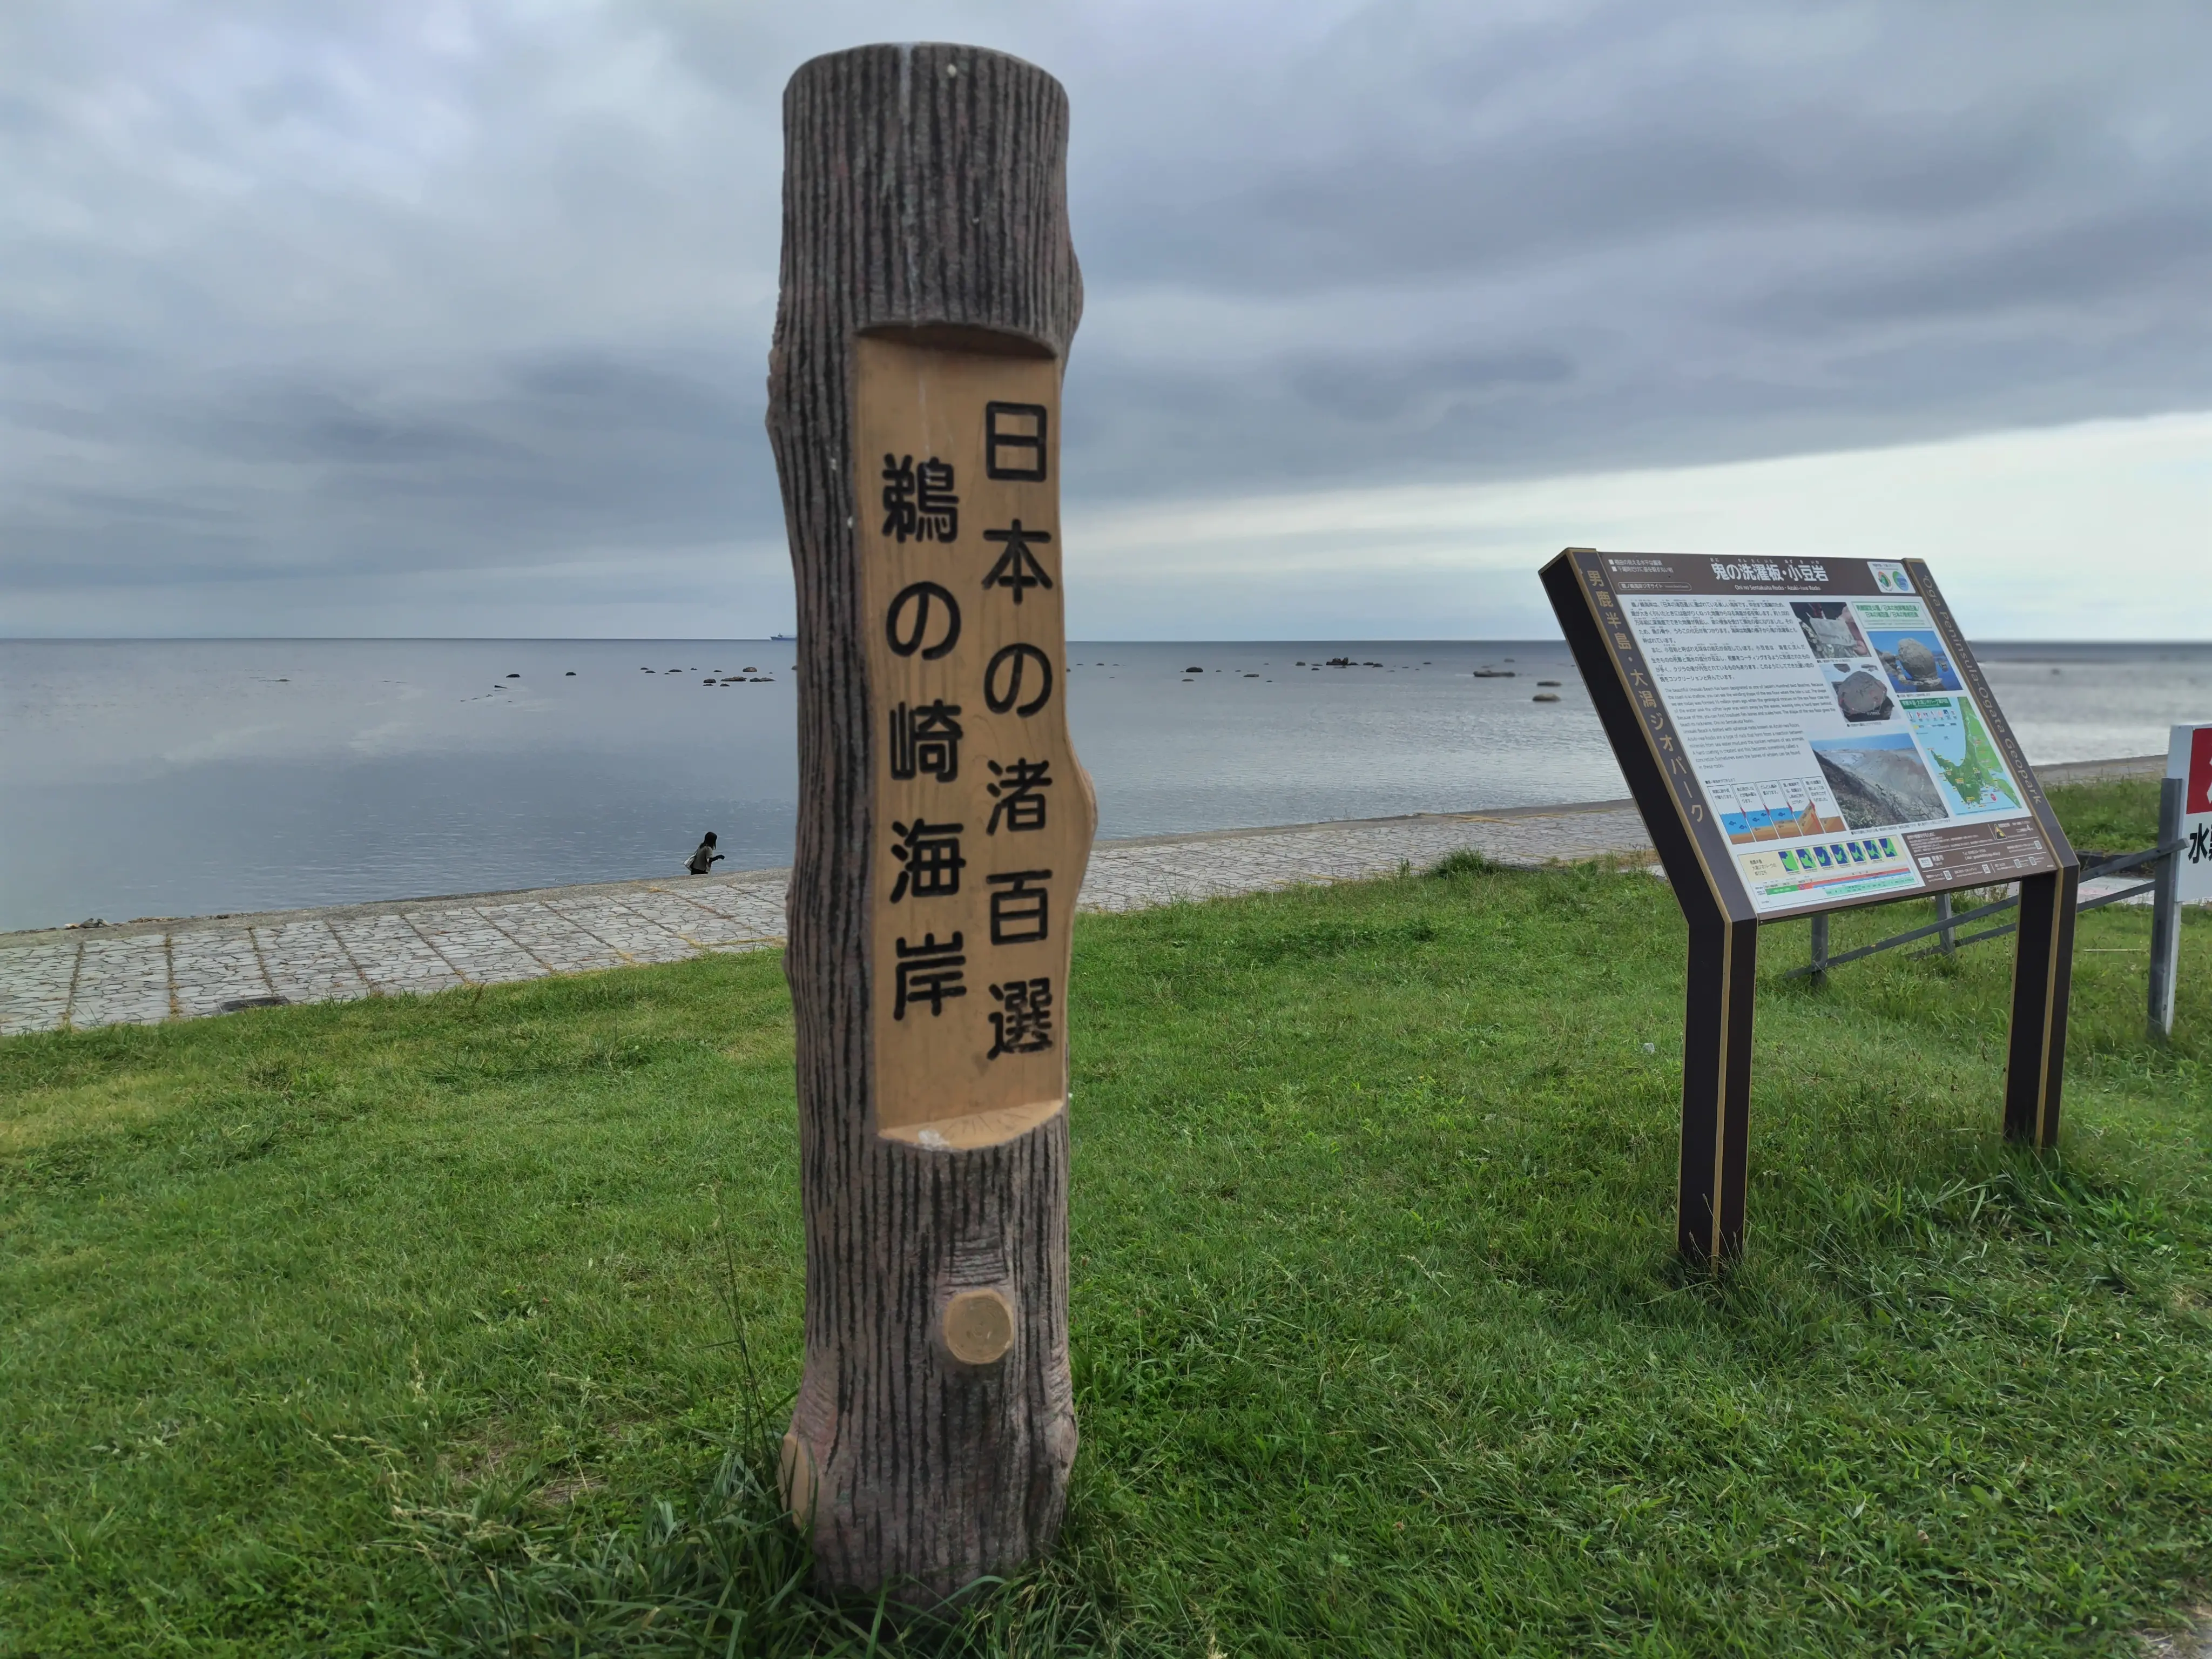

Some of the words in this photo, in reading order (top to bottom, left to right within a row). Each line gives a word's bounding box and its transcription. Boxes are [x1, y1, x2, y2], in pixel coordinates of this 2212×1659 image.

[1711, 563, 1829, 581] 鬼の洗濯板・小豆岩
[881, 453, 967, 1021] 鵜の崎海岸
[982, 400, 1053, 1060] 日本の渚百選
[1587, 570, 1703, 822] 男鹿半島・大潟ジオパーク
[1939, 611, 2005, 733] Peninsula-Ogata
[2004, 738, 2042, 804] Geopark
[2188, 823, 2212, 864] 水
